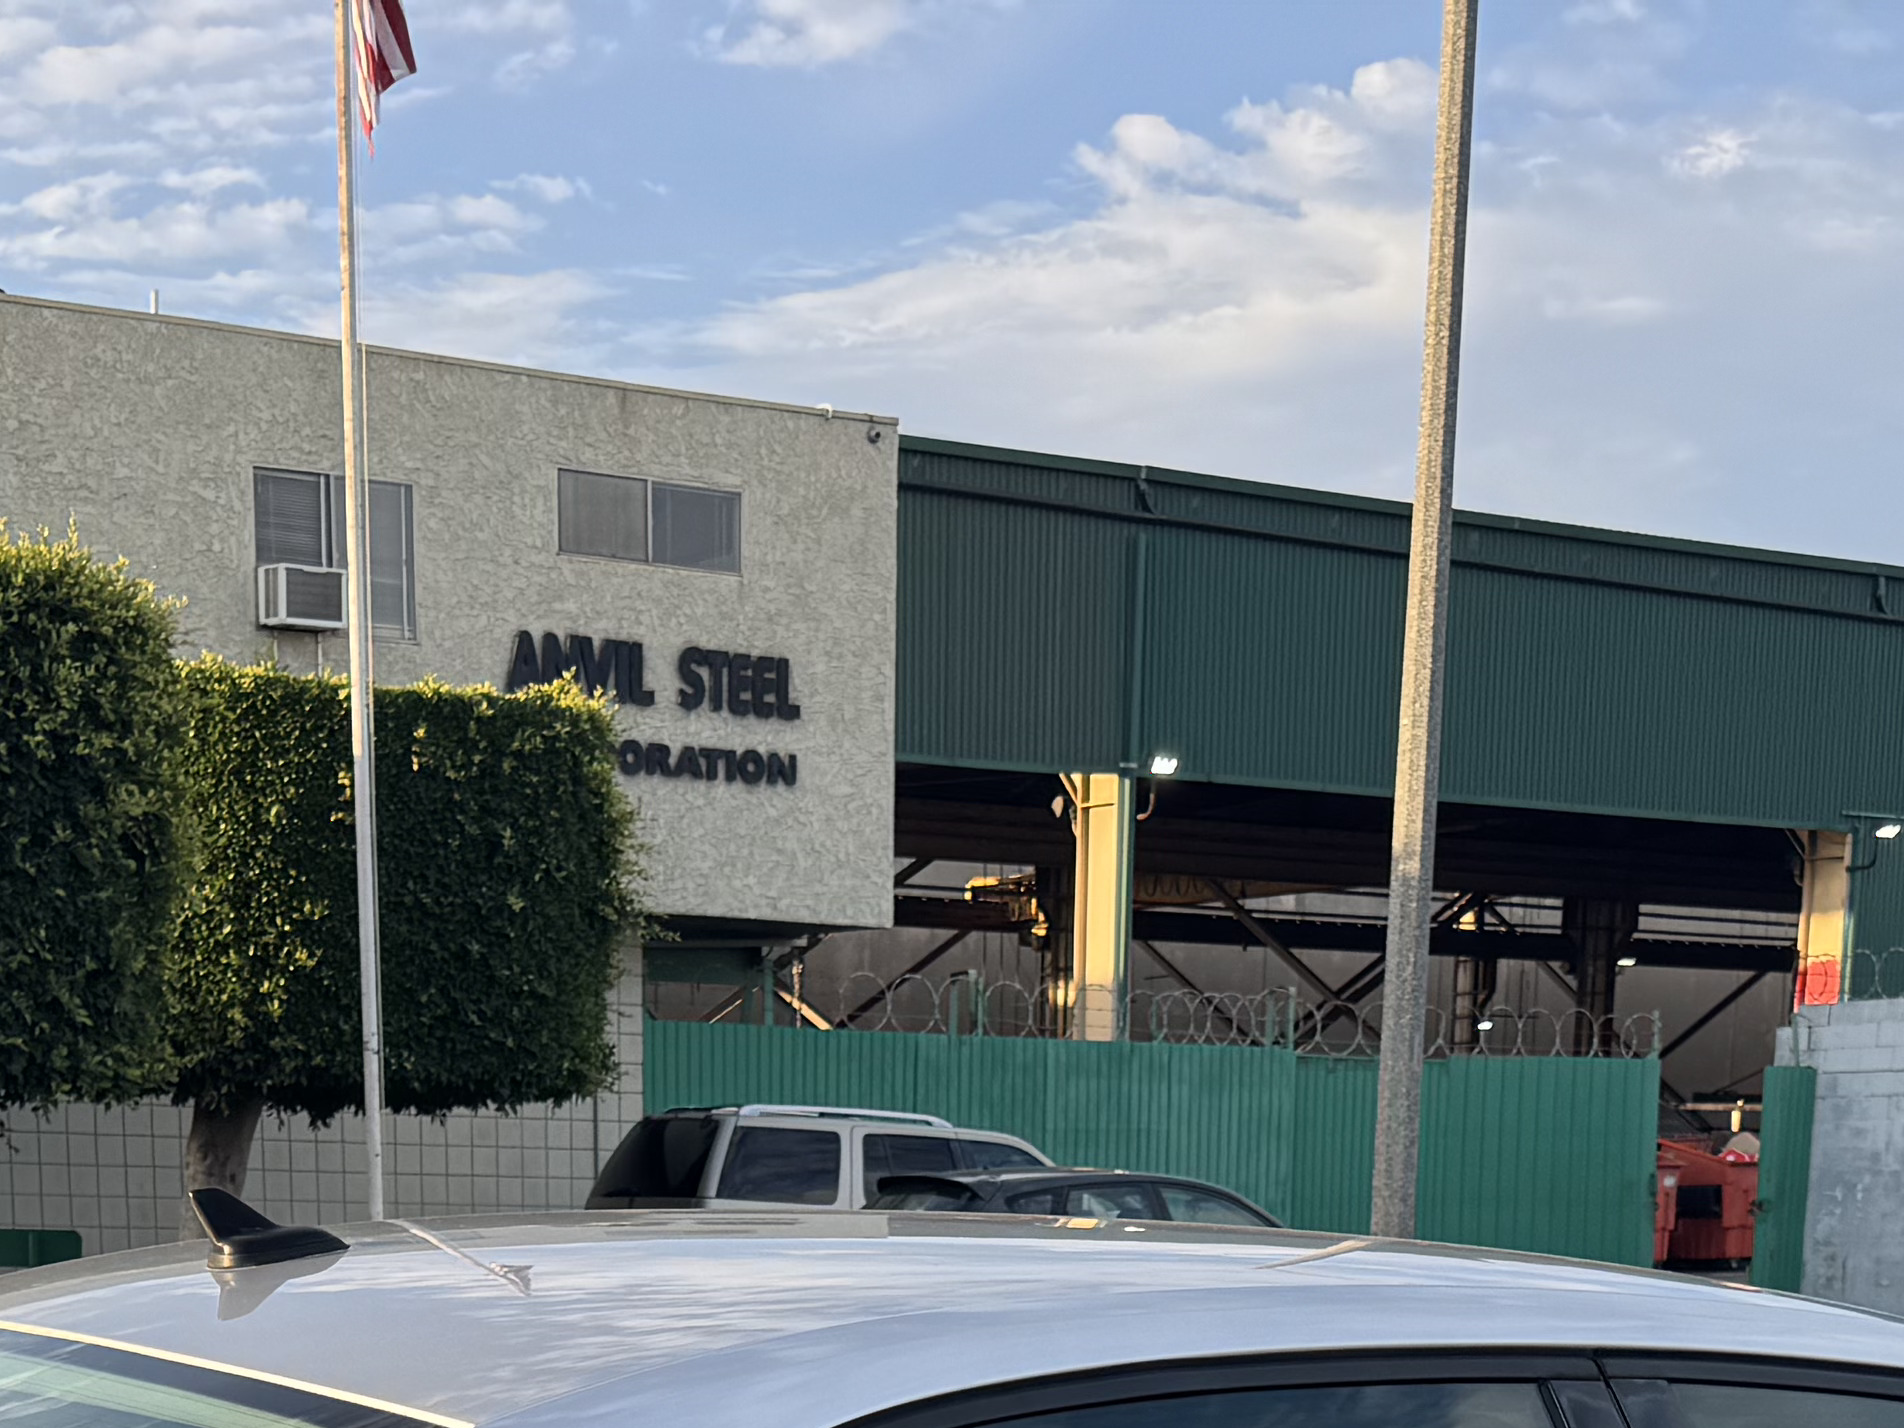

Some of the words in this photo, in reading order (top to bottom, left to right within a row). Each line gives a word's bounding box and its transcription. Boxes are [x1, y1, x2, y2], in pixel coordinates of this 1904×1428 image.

[506, 630, 655, 707] ANVIL
[678, 645, 801, 721] STEEL
[609, 739, 797, 787] ORATION
